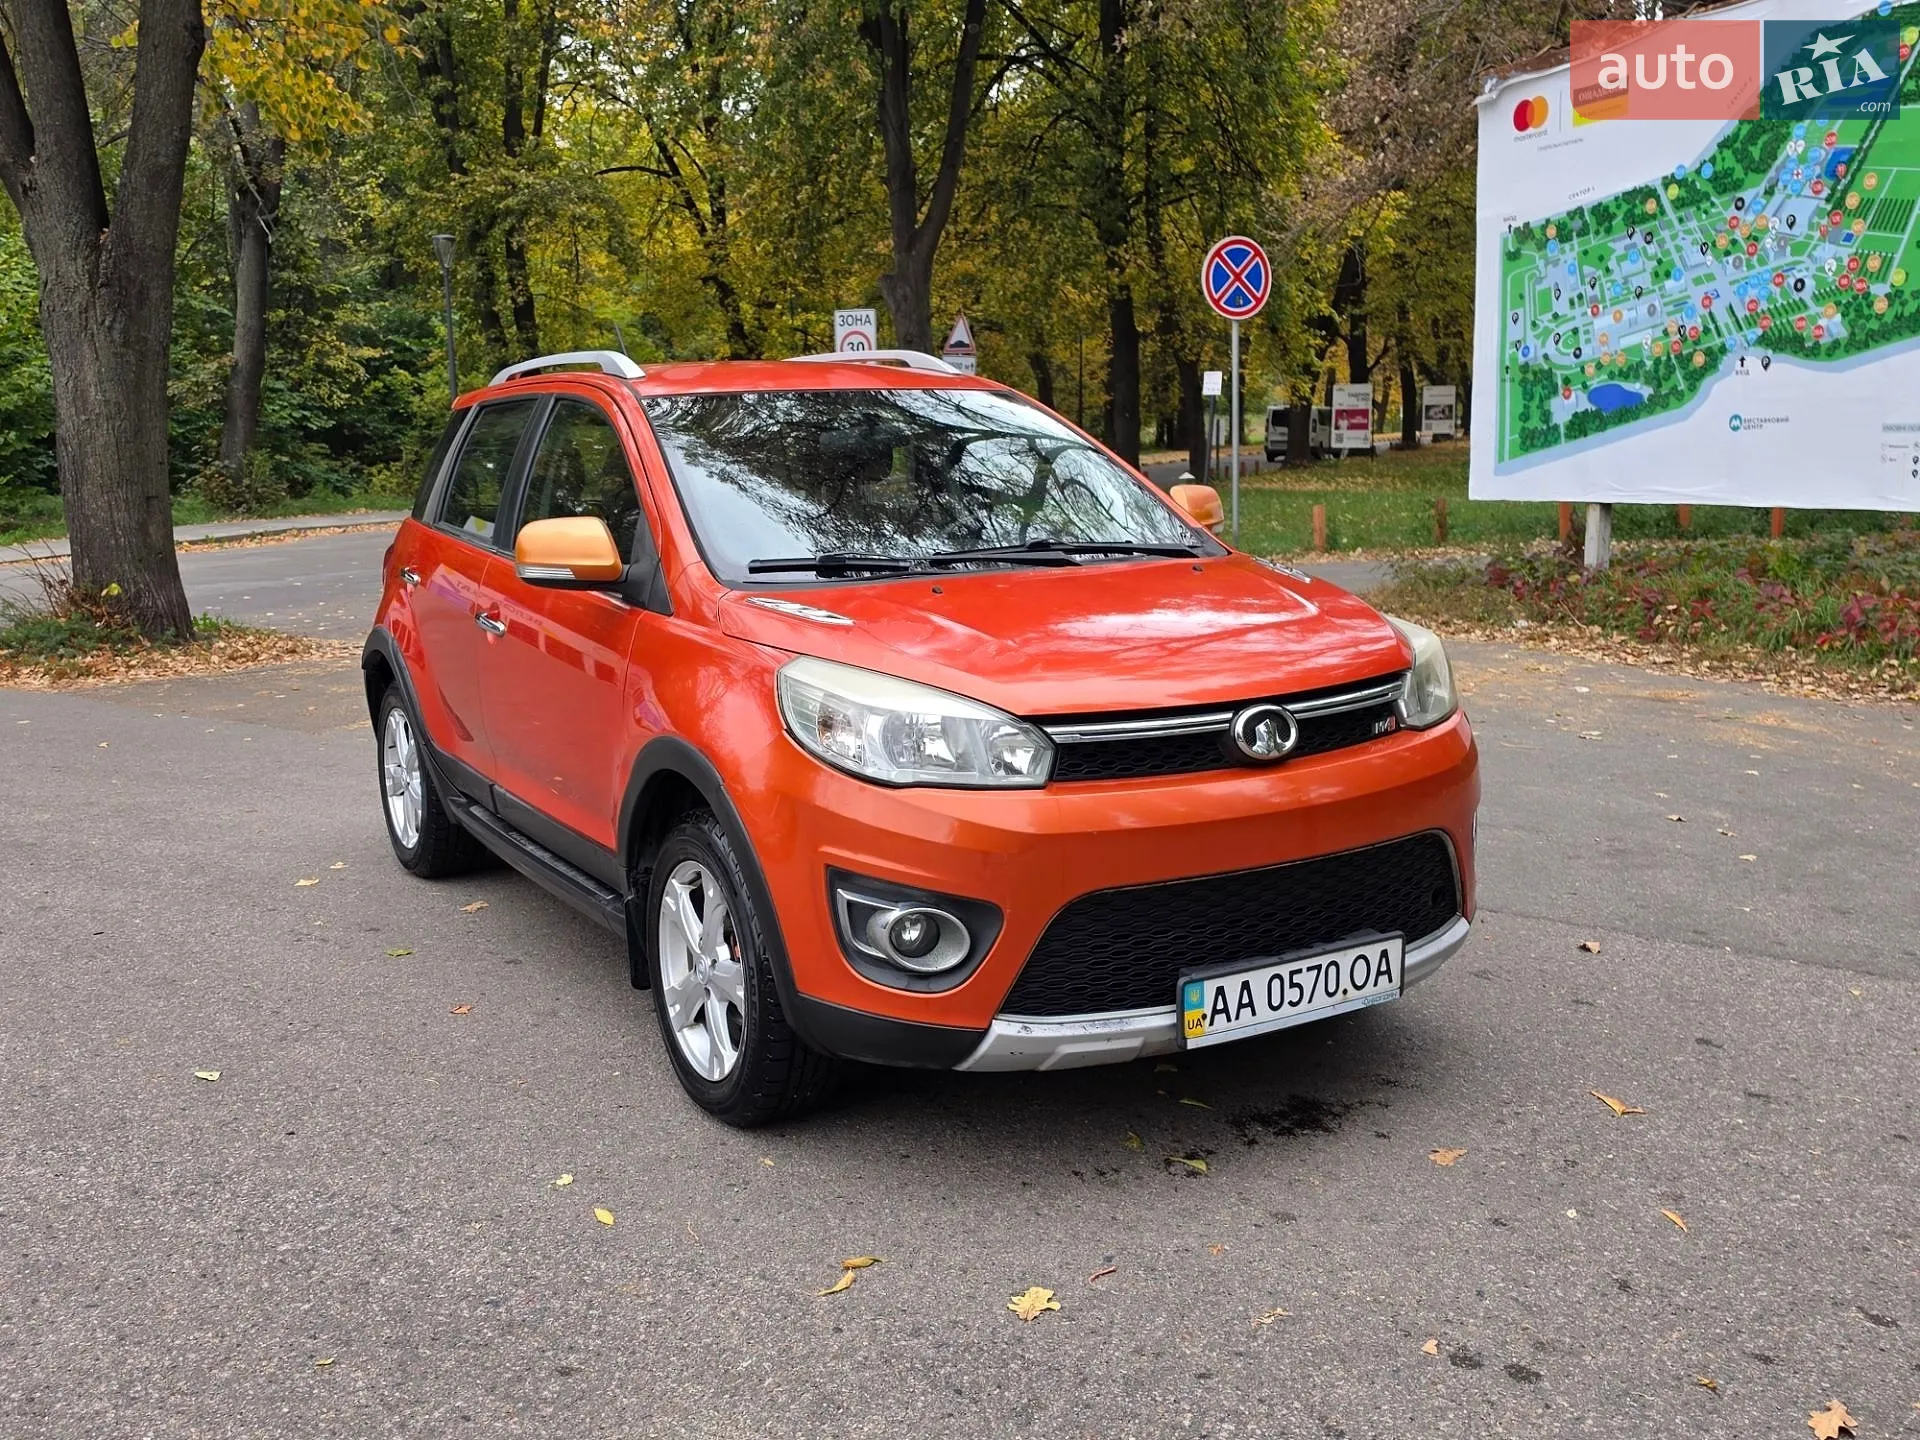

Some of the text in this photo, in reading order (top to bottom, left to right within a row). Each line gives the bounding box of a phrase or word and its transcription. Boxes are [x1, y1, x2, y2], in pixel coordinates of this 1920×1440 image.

[838, 314, 872, 327] ЗОНА
[847, 341, 865, 352] 30
[1208, 948, 1394, 1027] AA 0570 OA
[1187, 1017, 1203, 1030] UA
